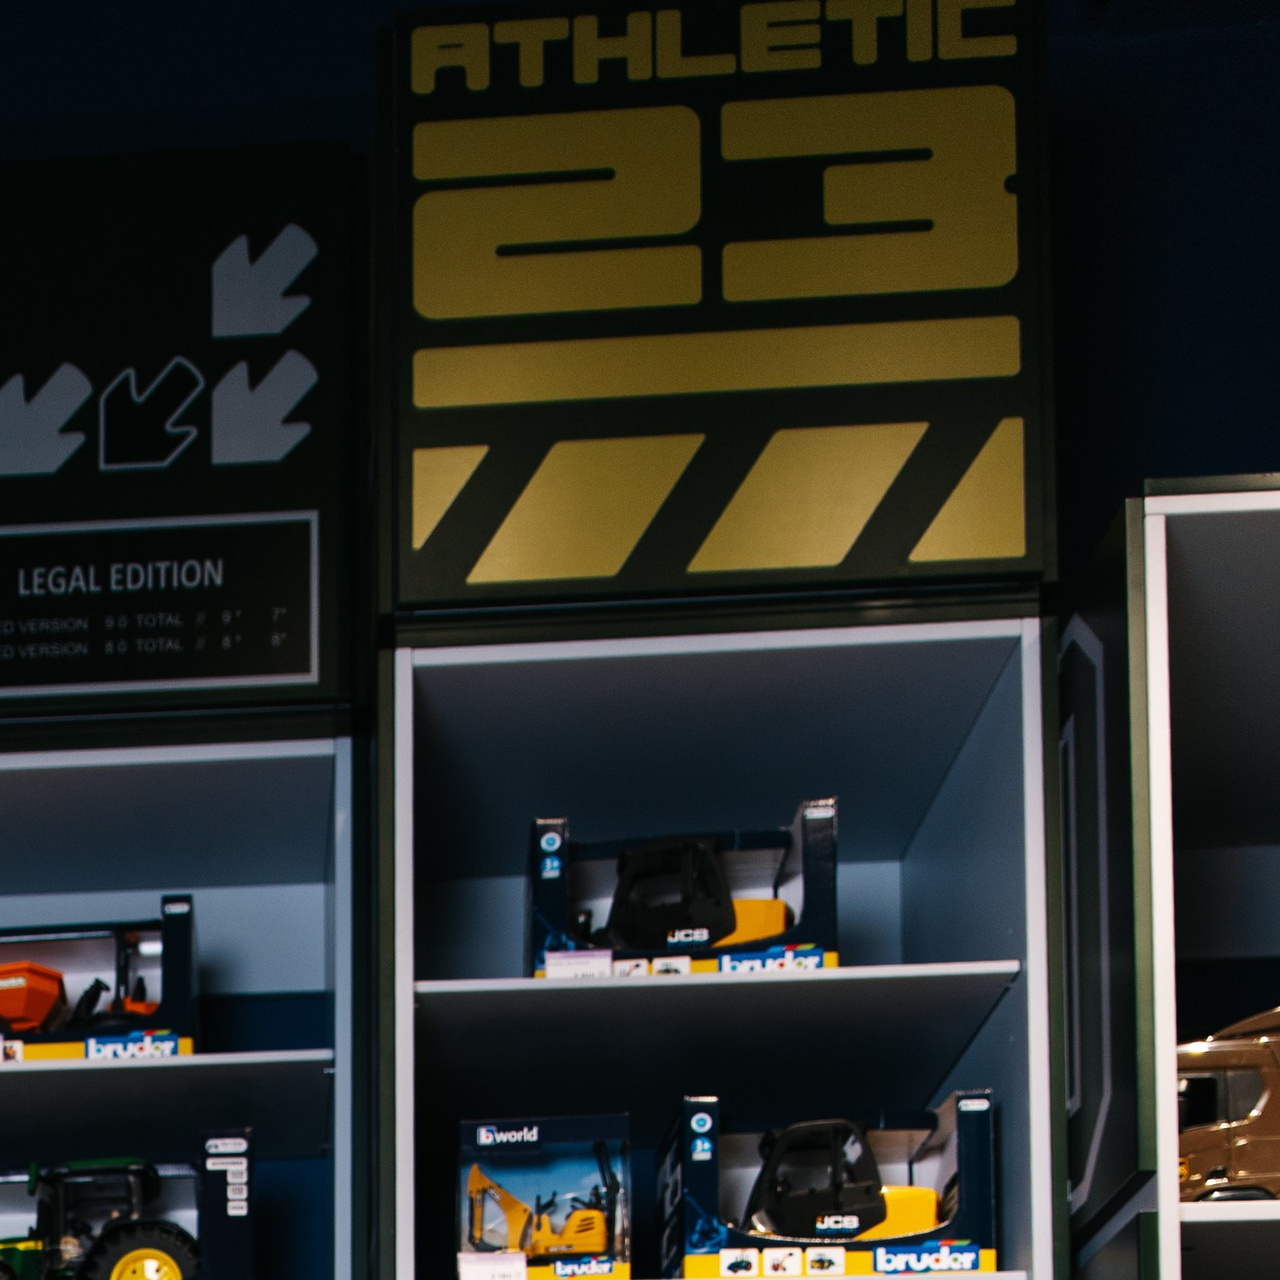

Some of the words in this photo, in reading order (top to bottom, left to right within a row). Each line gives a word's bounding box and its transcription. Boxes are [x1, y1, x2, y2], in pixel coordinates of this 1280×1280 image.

[411, 0, 1018, 95] ATHLETIC
[412, 84, 1019, 321] 23
[17, 563, 102, 597] LEGAL
[109, 557, 224, 592] EDITION
[668, 927, 709, 942] JCB
[722, 951, 821, 972] bruder
[87, 1034, 175, 1059] bruder
[816, 1215, 860, 1230] JCB
[555, 1259, 612, 1277] bruder
[876, 1245, 976, 1272] bruder
